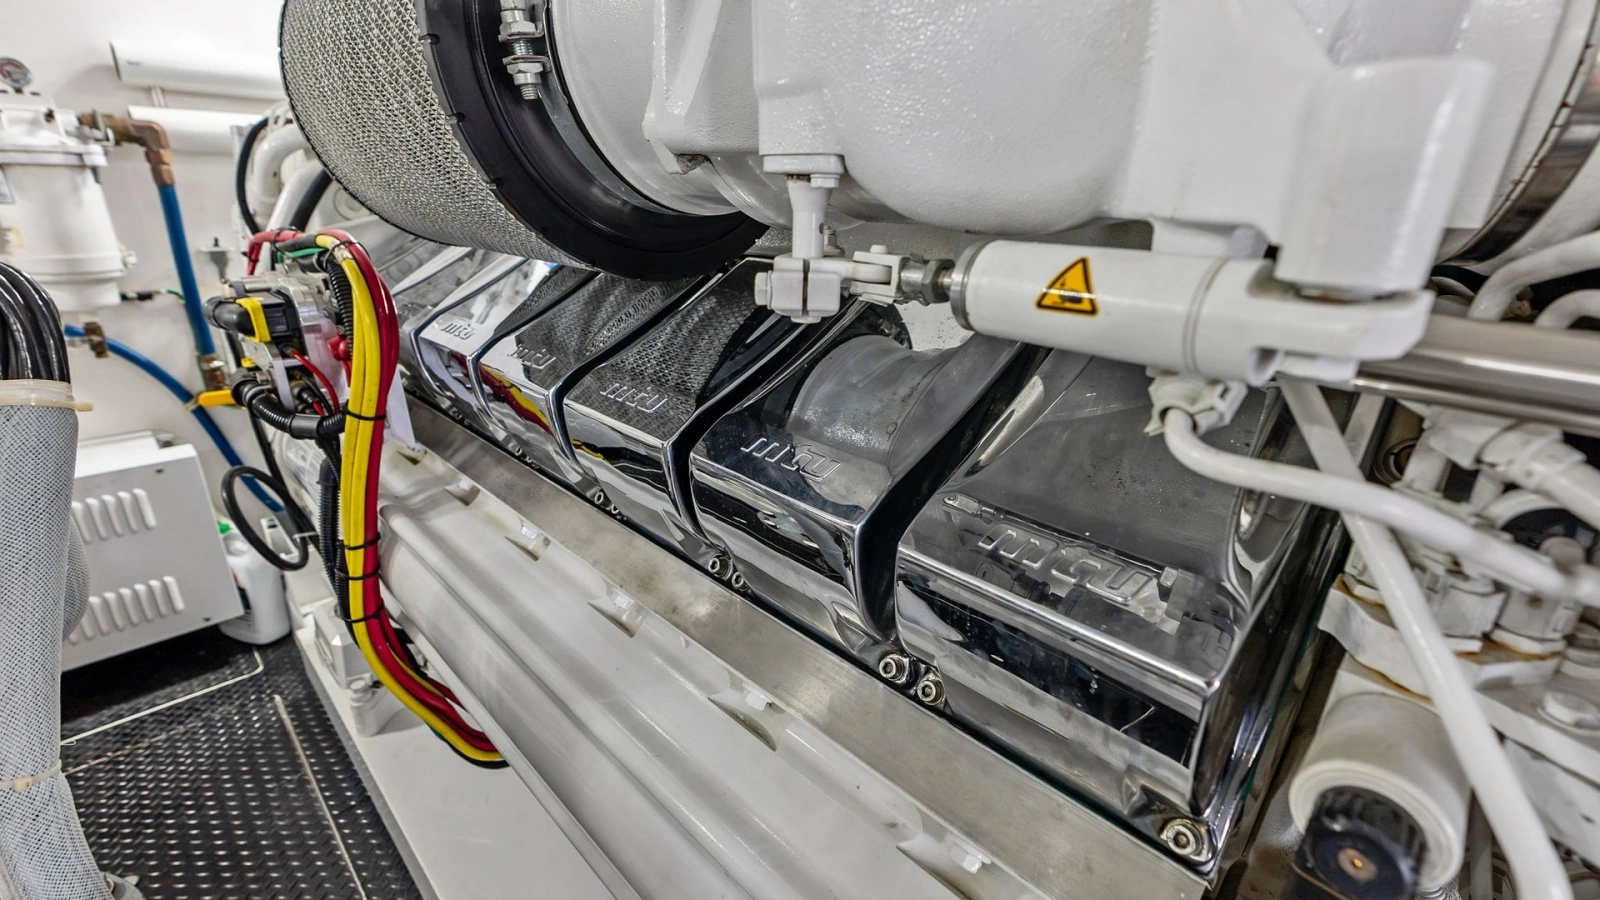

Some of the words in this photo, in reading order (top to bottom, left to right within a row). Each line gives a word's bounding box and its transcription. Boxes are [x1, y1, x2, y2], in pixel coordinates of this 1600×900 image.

[441, 320, 476, 340] mtu
[600, 382, 668, 414] mtu
[740, 435, 842, 482] mtu
[977, 522, 1153, 605] mtu
